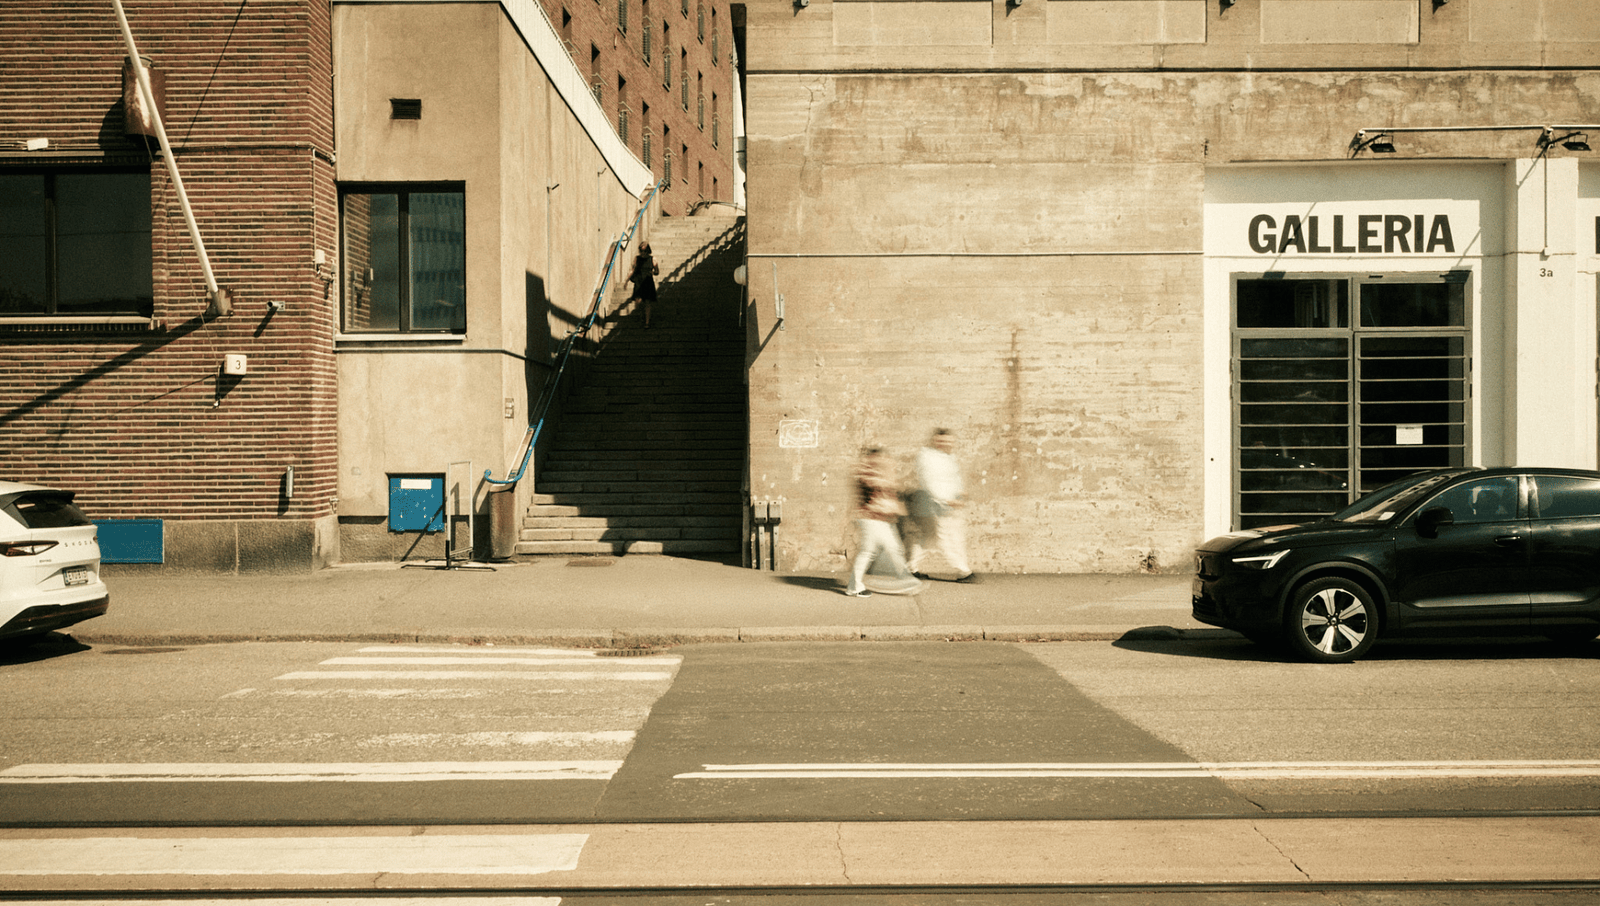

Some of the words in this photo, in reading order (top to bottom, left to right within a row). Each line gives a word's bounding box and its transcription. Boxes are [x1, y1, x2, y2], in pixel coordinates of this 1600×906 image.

[1248, 214, 1455, 253] GALLERIA
[1539, 267, 1554, 278] 3a
[235, 359, 242, 370] 3
